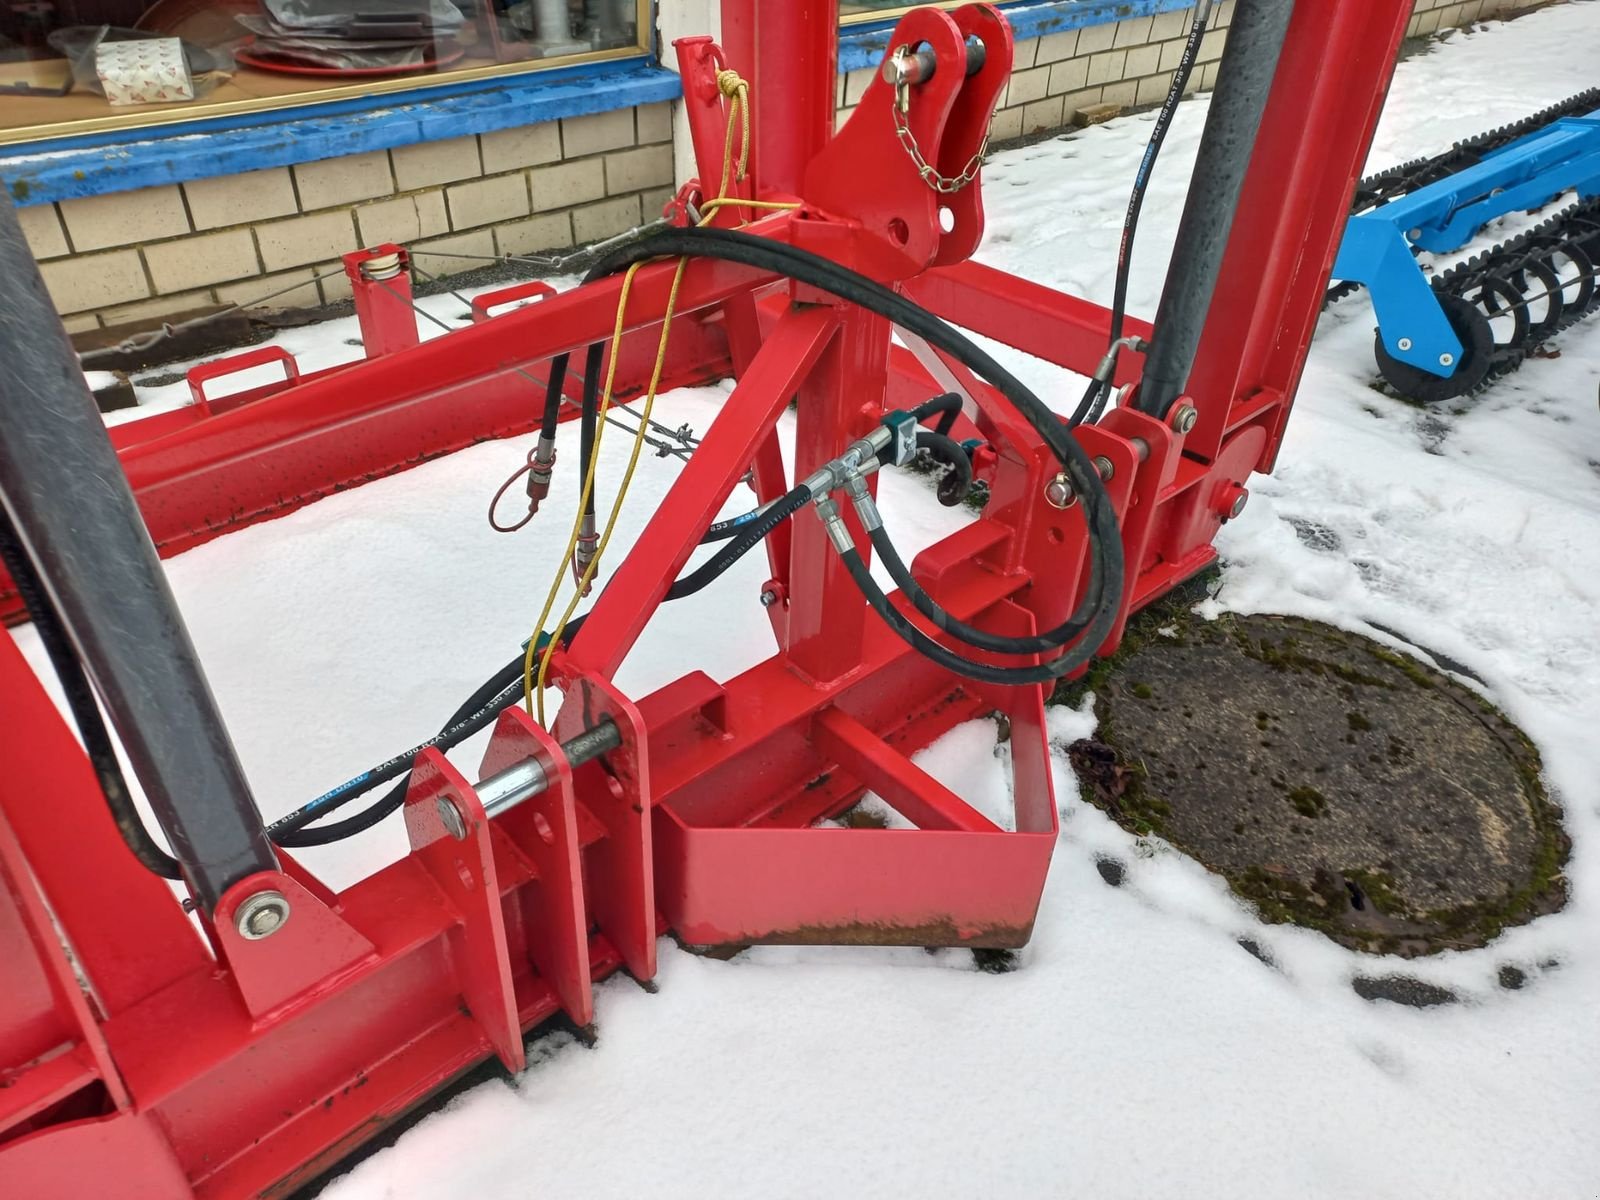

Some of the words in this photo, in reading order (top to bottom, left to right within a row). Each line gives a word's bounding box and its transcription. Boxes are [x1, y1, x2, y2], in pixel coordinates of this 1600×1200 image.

[1152, 123, 1162, 140] SAE
[1160, 108, 1169, 121] 100
[1183, 50, 1190, 65] WP
[1188, 32, 1197, 48] 330
[375, 758, 399, 772] SAE
[402, 747, 419, 759] 100
[470, 708, 486, 720] WP
[485, 695, 503, 710] 330
